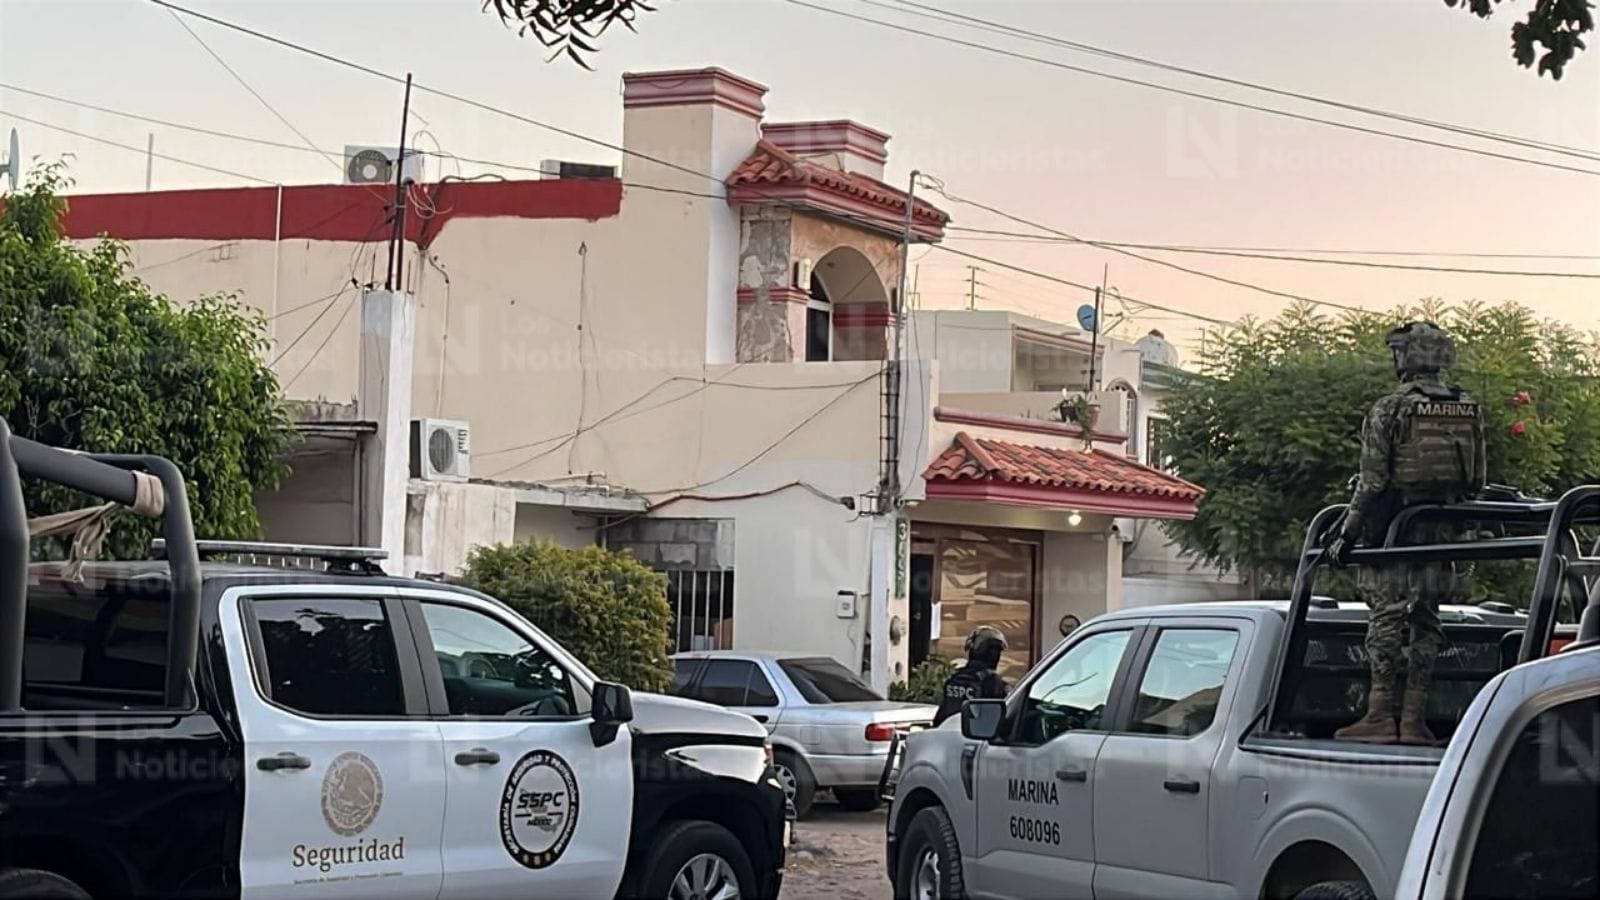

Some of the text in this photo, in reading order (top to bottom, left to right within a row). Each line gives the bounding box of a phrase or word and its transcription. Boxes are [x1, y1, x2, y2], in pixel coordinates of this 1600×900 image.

[1417, 403, 1476, 417] MARINA
[945, 685, 975, 700] SSPC
[516, 791, 565, 809] SSPC
[1008, 778, 1060, 806] MARINA
[1009, 815, 1061, 846] 608096
[292, 836, 405, 873] Seguridad
